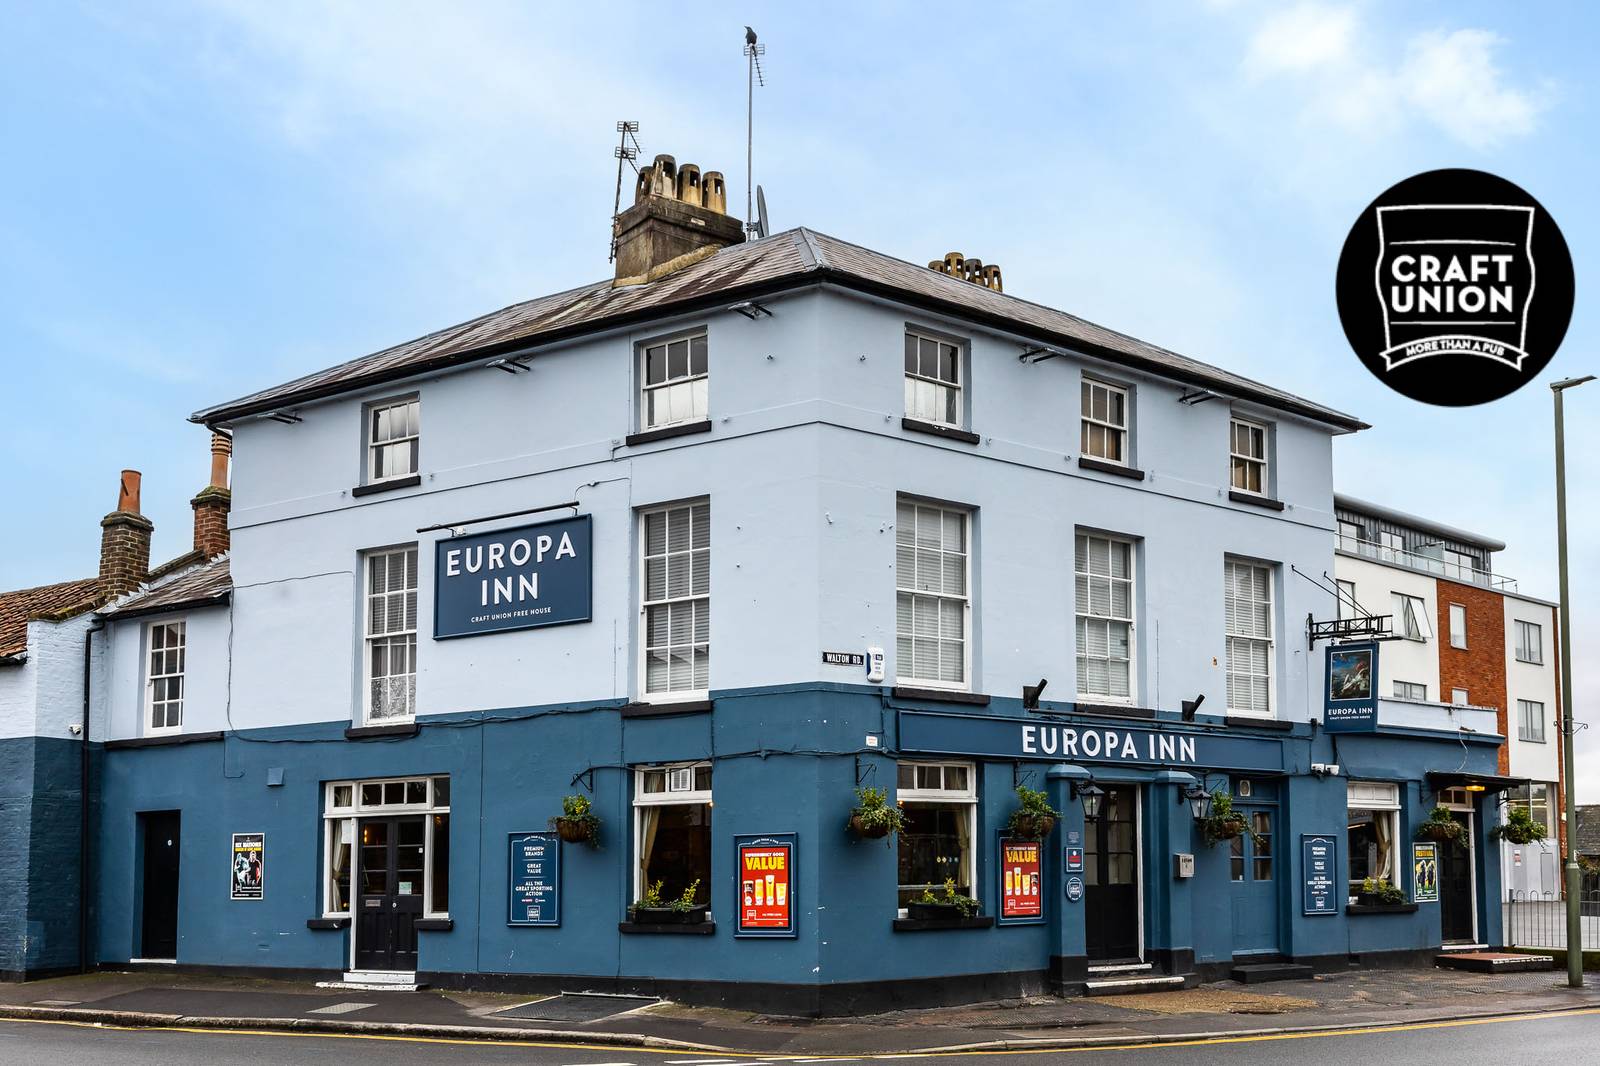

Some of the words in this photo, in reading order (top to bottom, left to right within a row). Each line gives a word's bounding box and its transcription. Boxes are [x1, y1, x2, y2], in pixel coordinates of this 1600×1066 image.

[446, 531, 576, 577] EUROPA
[481, 572, 538, 606] INN
[471, 614, 490, 623] CRAFT
[491, 611, 512, 621] UNION
[513, 609, 529, 618] FREE
[530, 606, 552, 615] HOUSE
[826, 653, 850, 664] WALTON
[852, 655, 863, 664] RD.
[1022, 725, 1139, 759] EUROPA
[1149, 734, 1196, 763] INN
[745, 856, 785, 870] VALUE
[1006, 850, 1037, 863] VALUE
